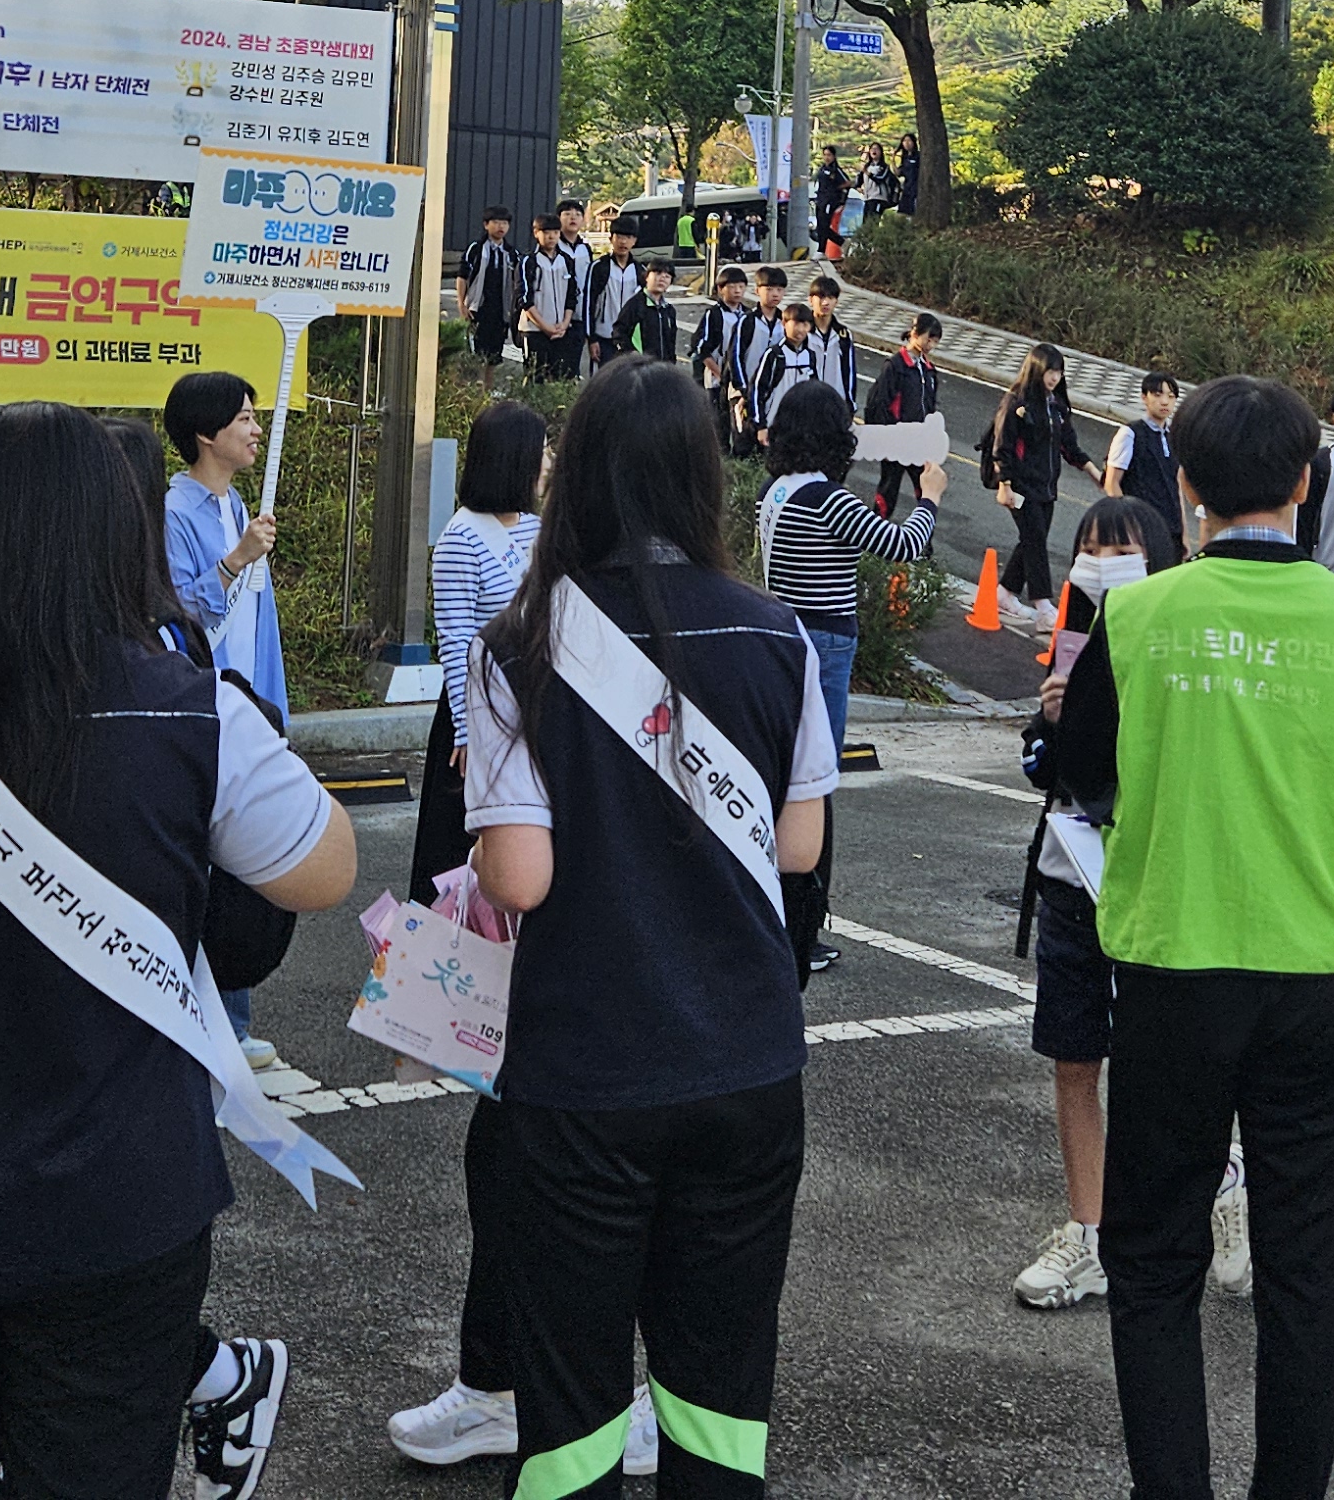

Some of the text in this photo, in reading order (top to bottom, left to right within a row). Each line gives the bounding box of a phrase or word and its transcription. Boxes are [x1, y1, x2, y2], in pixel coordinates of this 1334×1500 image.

[181, 29, 374, 60] 2024. 경남 초중학생대회
[52, 71, 89, 91] 남자
[94, 74, 150, 97] 단체전
[230, 61, 374, 88] 강민성 김주승 김유민
[229, 85, 324, 108] 강수빈 김주원
[3, 113, 61, 135] 단체전
[226, 122, 370, 149] 김준기 유지후 김도연
[264, 220, 349, 245] 정신건강은
[120, 244, 178, 258] 거제시보건소
[213, 243, 390, 273] 마주하면서 시작합니다
[217, 273, 269, 287] 거제시보건소
[272, 276, 338, 291] 정신건강복지센터
[56, 339, 78, 362] 의
[85, 340, 152, 364] 과태료
[158, 342, 201, 366] 부과
[679, 742, 754, 819] 마음이
[20, 861, 105, 939] 보건소
[479, 1023, 504, 1043] 109
